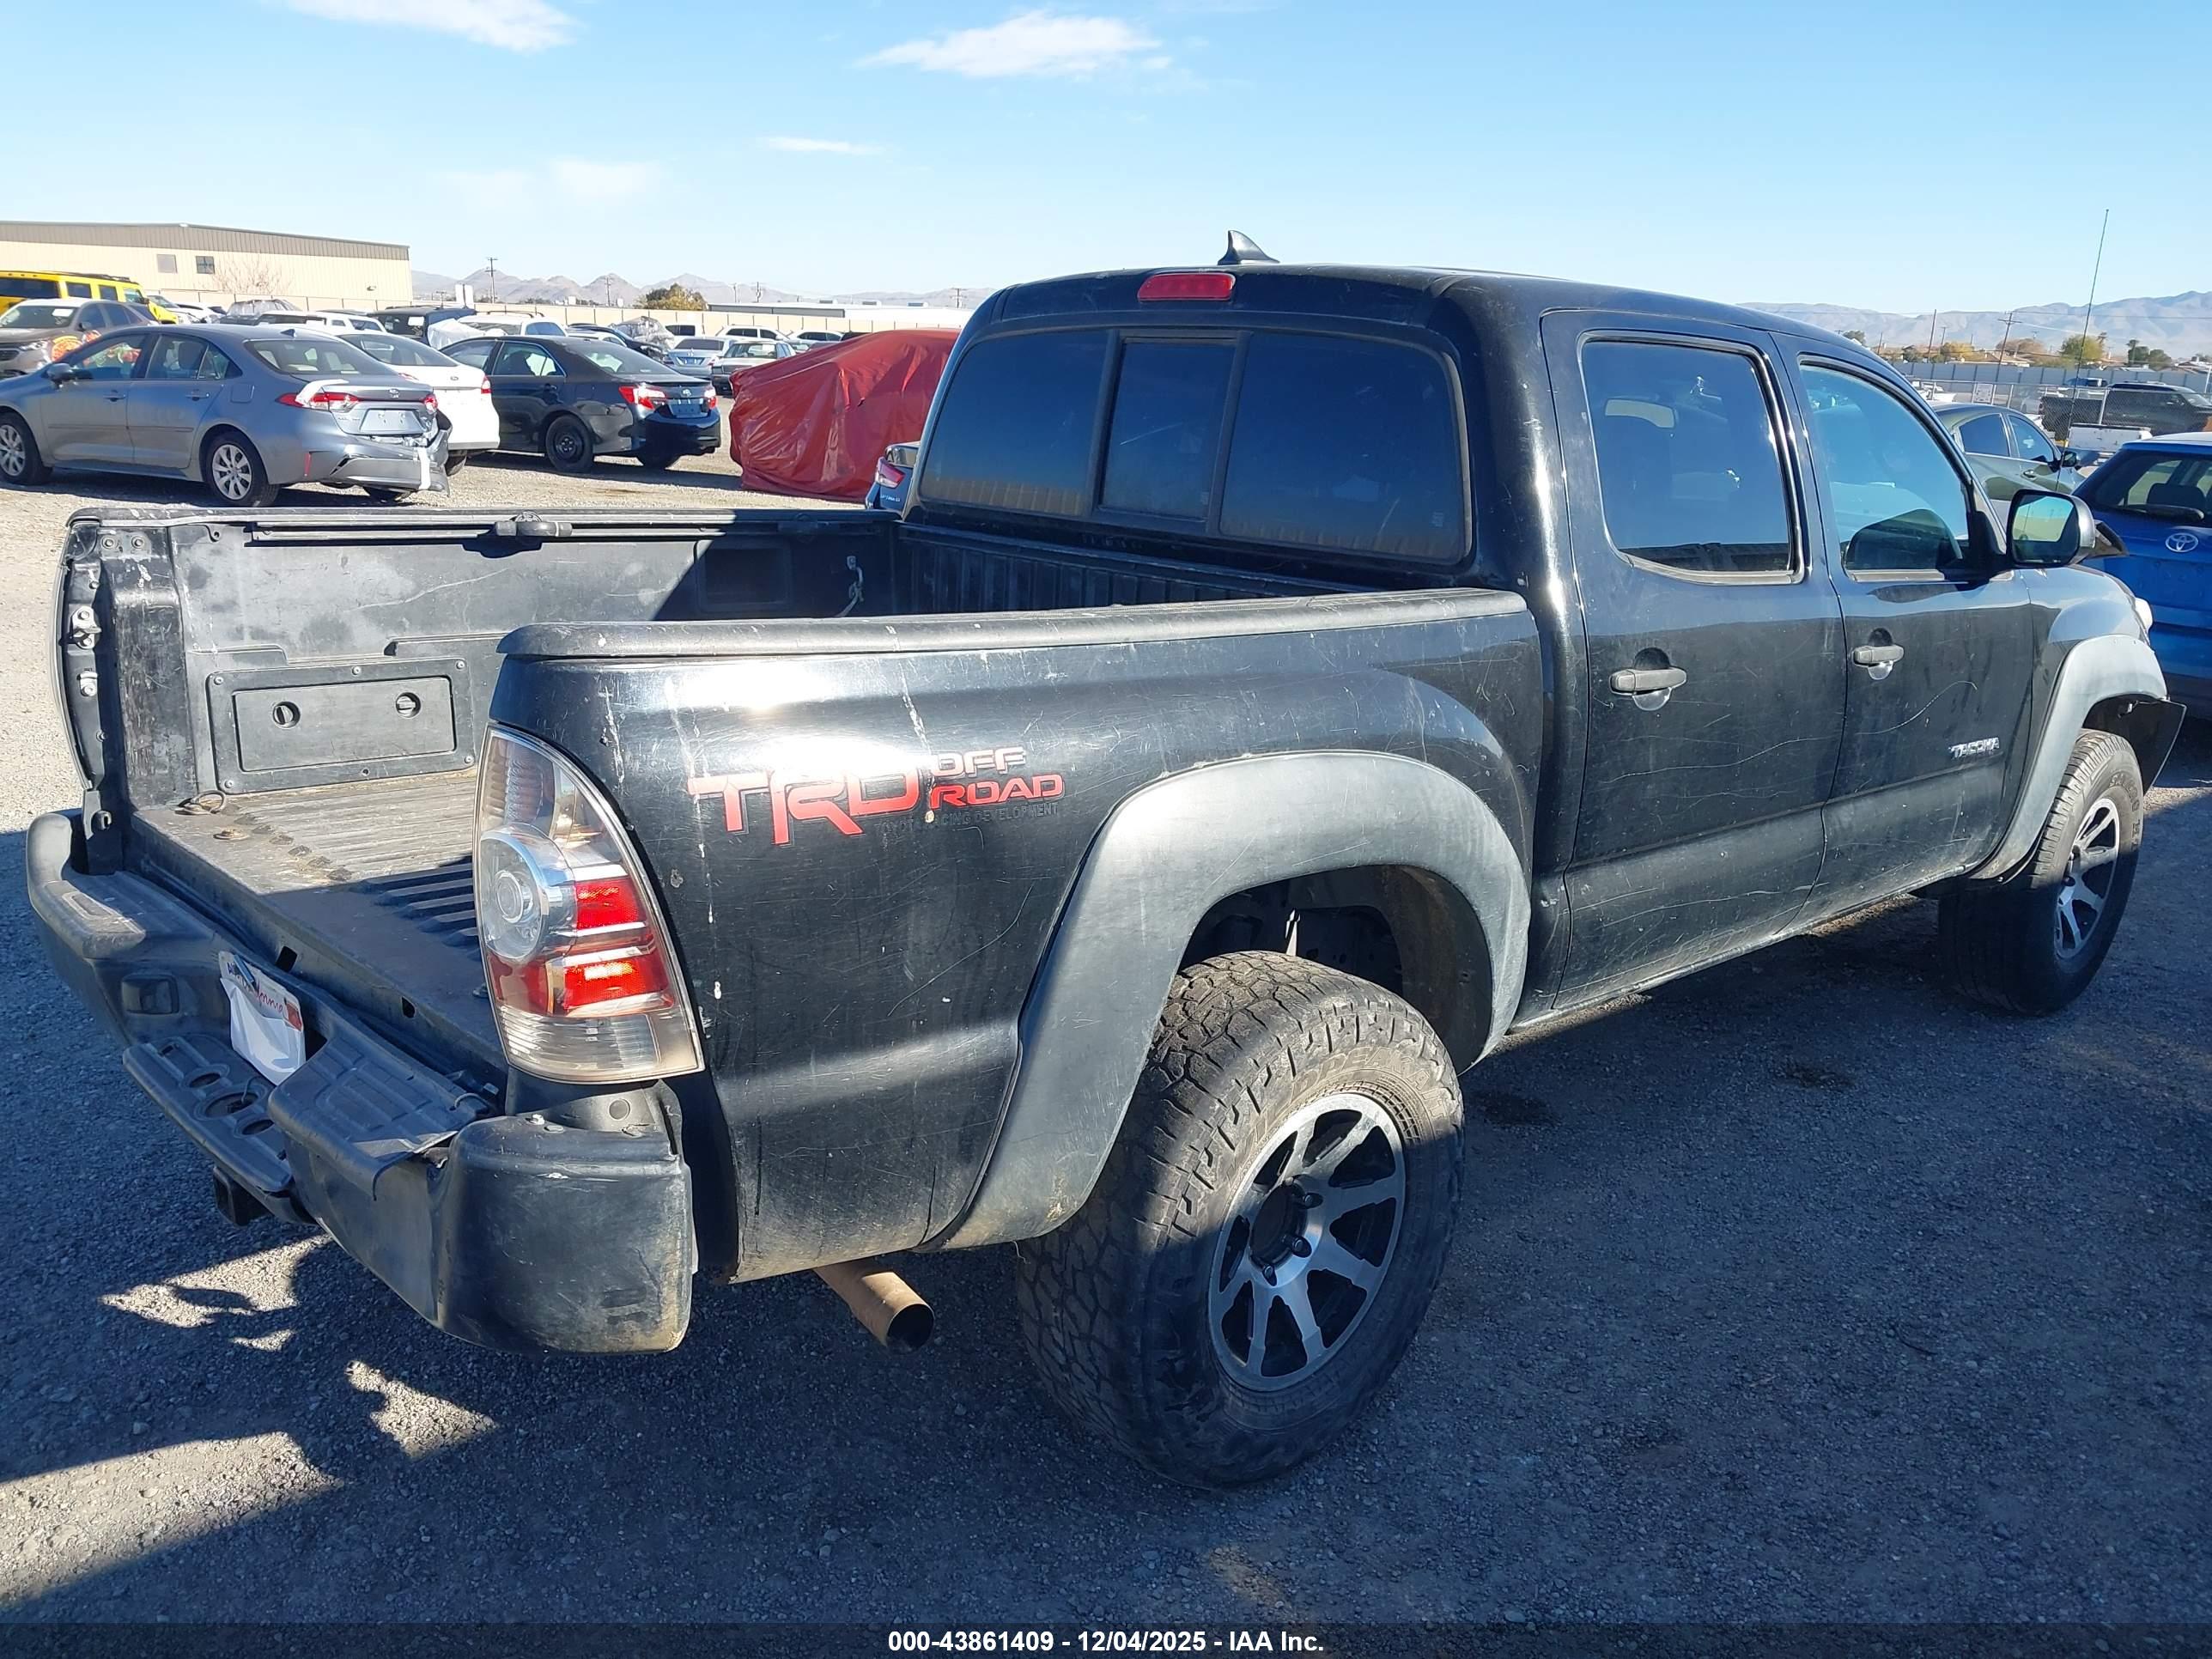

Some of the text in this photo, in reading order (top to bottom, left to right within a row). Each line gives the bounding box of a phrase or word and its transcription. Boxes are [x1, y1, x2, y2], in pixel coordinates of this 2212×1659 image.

[931, 746, 1026, 777] OFF
[686, 761, 921, 846] TRD
[929, 774, 1065, 811] ROAD
